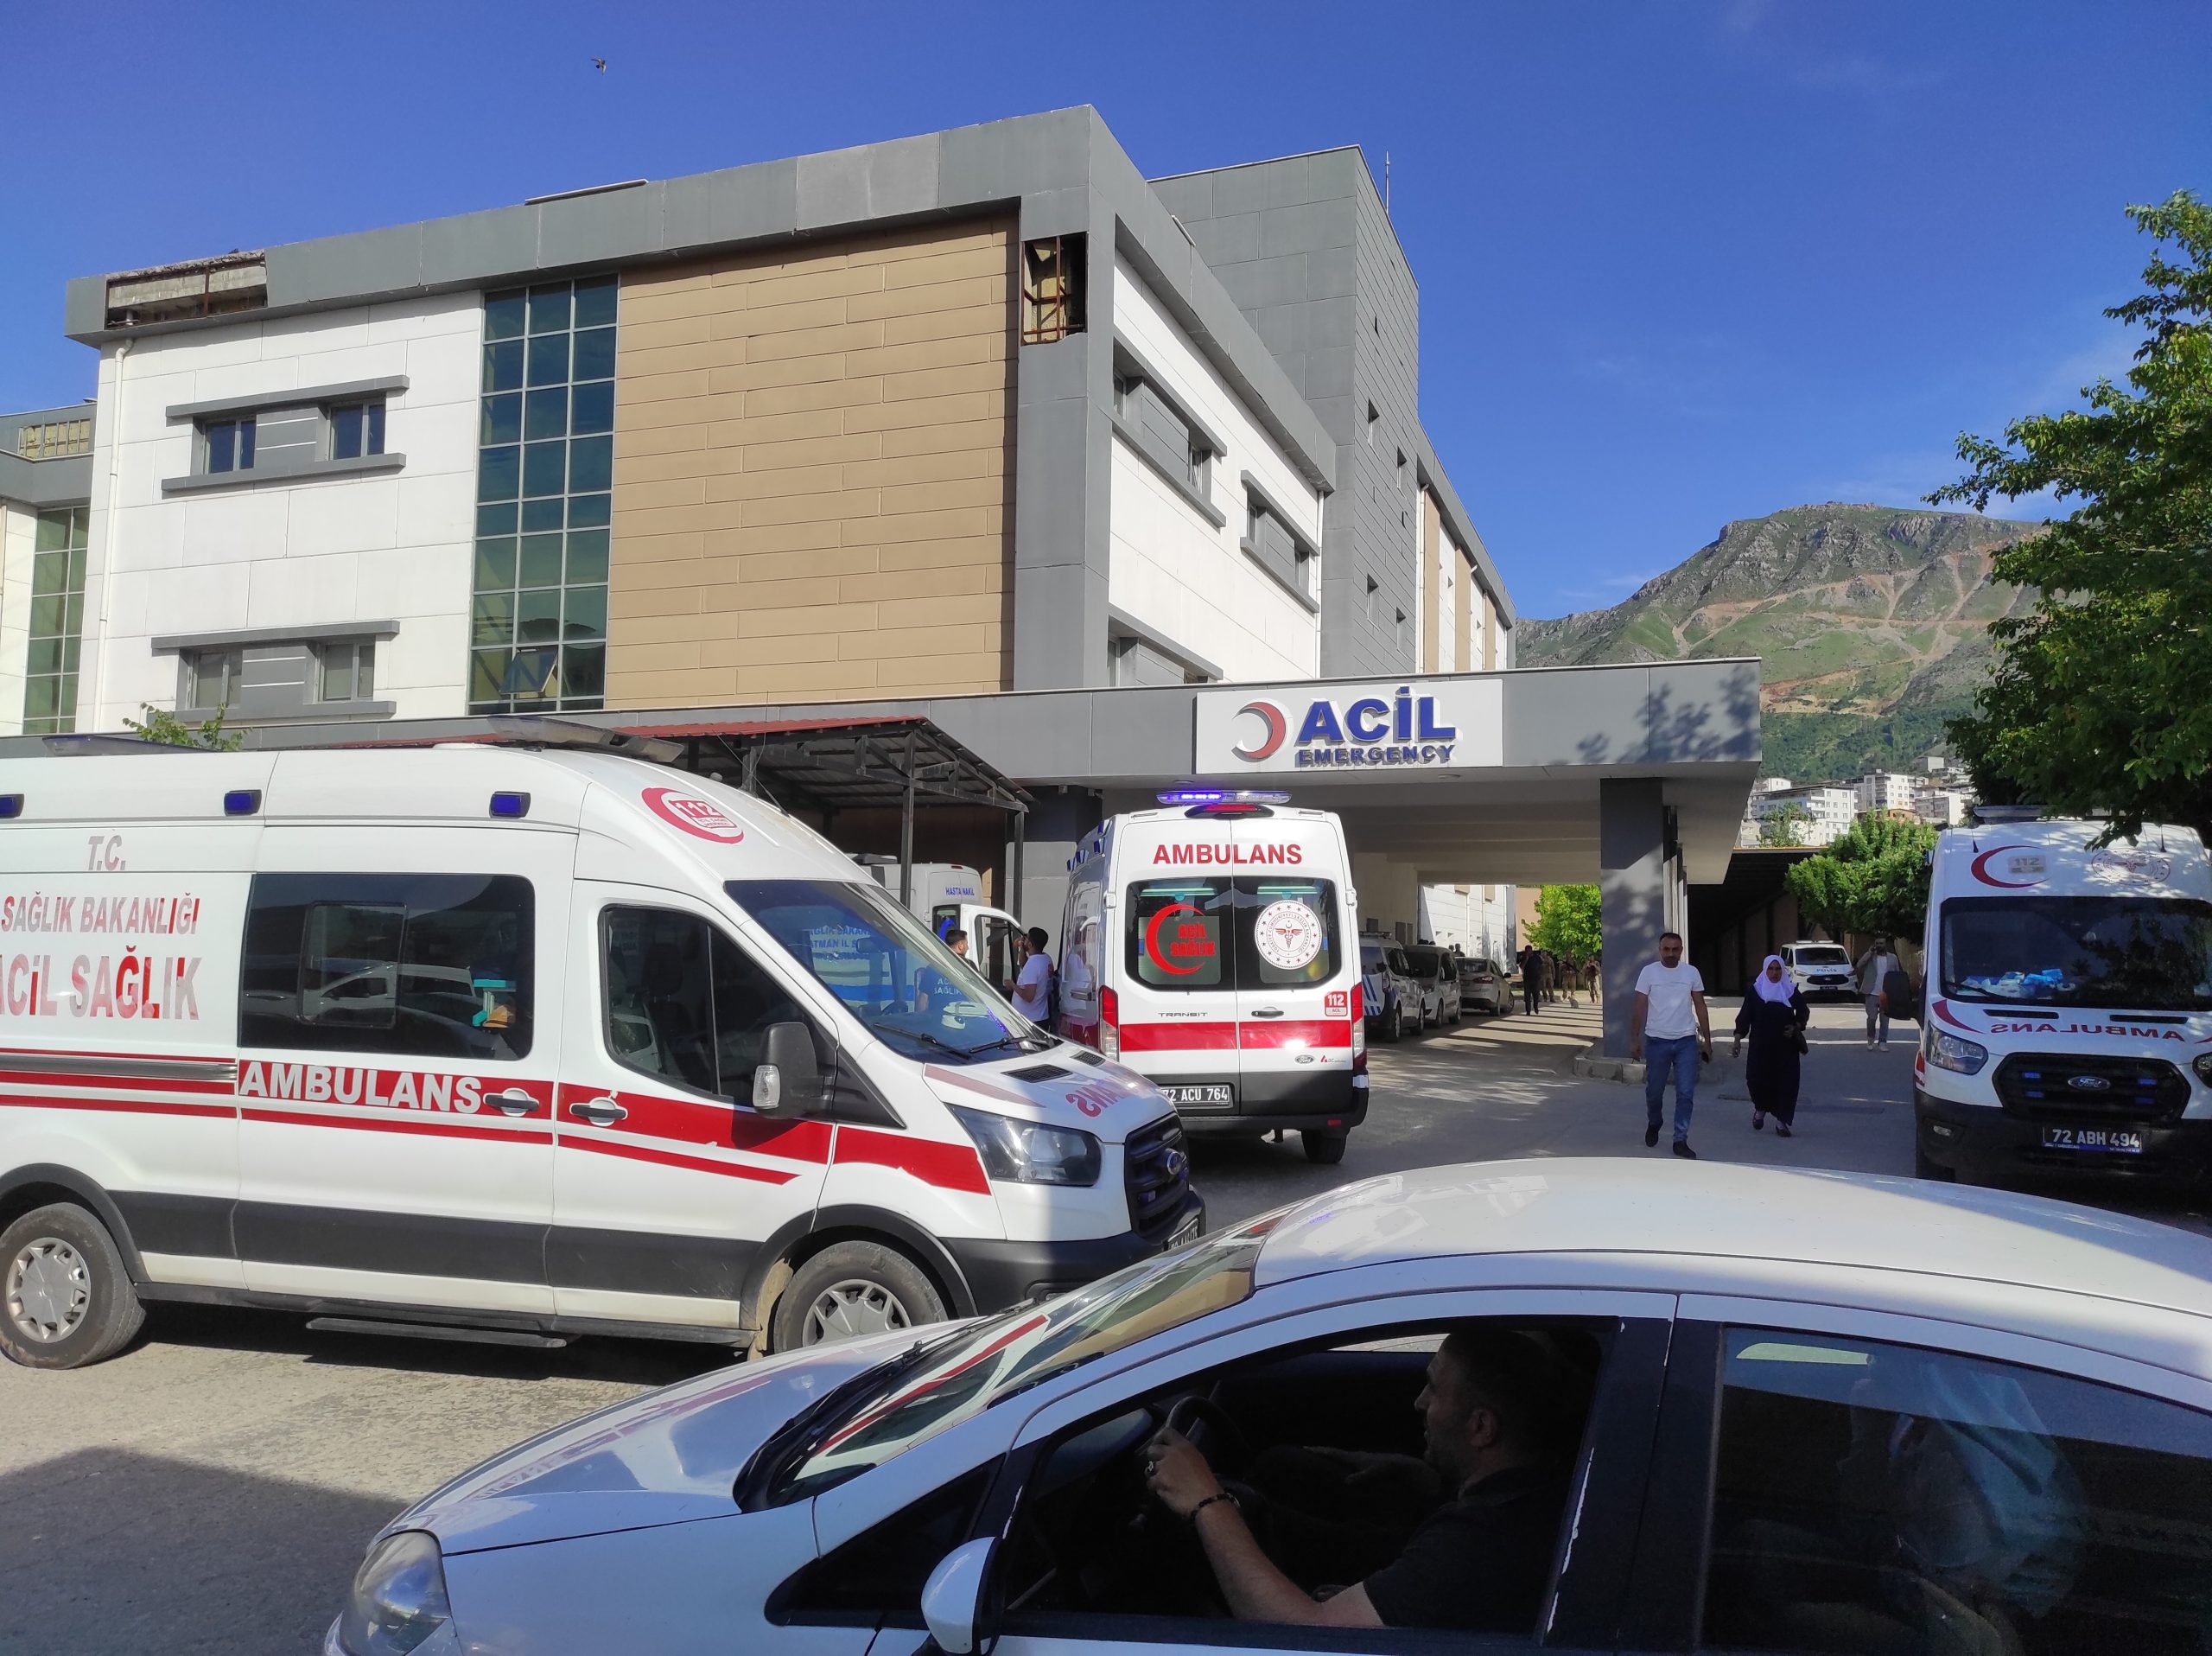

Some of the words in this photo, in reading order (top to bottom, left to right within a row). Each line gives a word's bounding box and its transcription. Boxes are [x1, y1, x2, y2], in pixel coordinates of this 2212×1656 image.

[1296, 685, 1457, 743] ACİL
[1298, 745, 1455, 765] EMERGENCY
[674, 801, 721, 817] 112
[87, 834, 127, 871] T.C.
[1153, 844, 1302, 864] AMBULANS
[2014, 857, 2039, 866] 112
[945, 887, 962, 895] HASTA
[1, 890, 77, 933] SAĞLIK
[79, 892, 200, 935] BAKANLIĞI
[69, 945, 202, 1021] SAĞLIK
[1327, 994, 1345, 1006] 112
[238, 1061, 482, 1114] AMBULANS
[2079, 1078, 2102, 1088] Ford
[1180, 1088, 1202, 1101] ACU
[1206, 1087, 1228, 1101] 764
[2052, 1128, 2072, 1143] 72
[2076, 1131, 2107, 1145] ABH
[2109, 1133, 2140, 1148] 494
